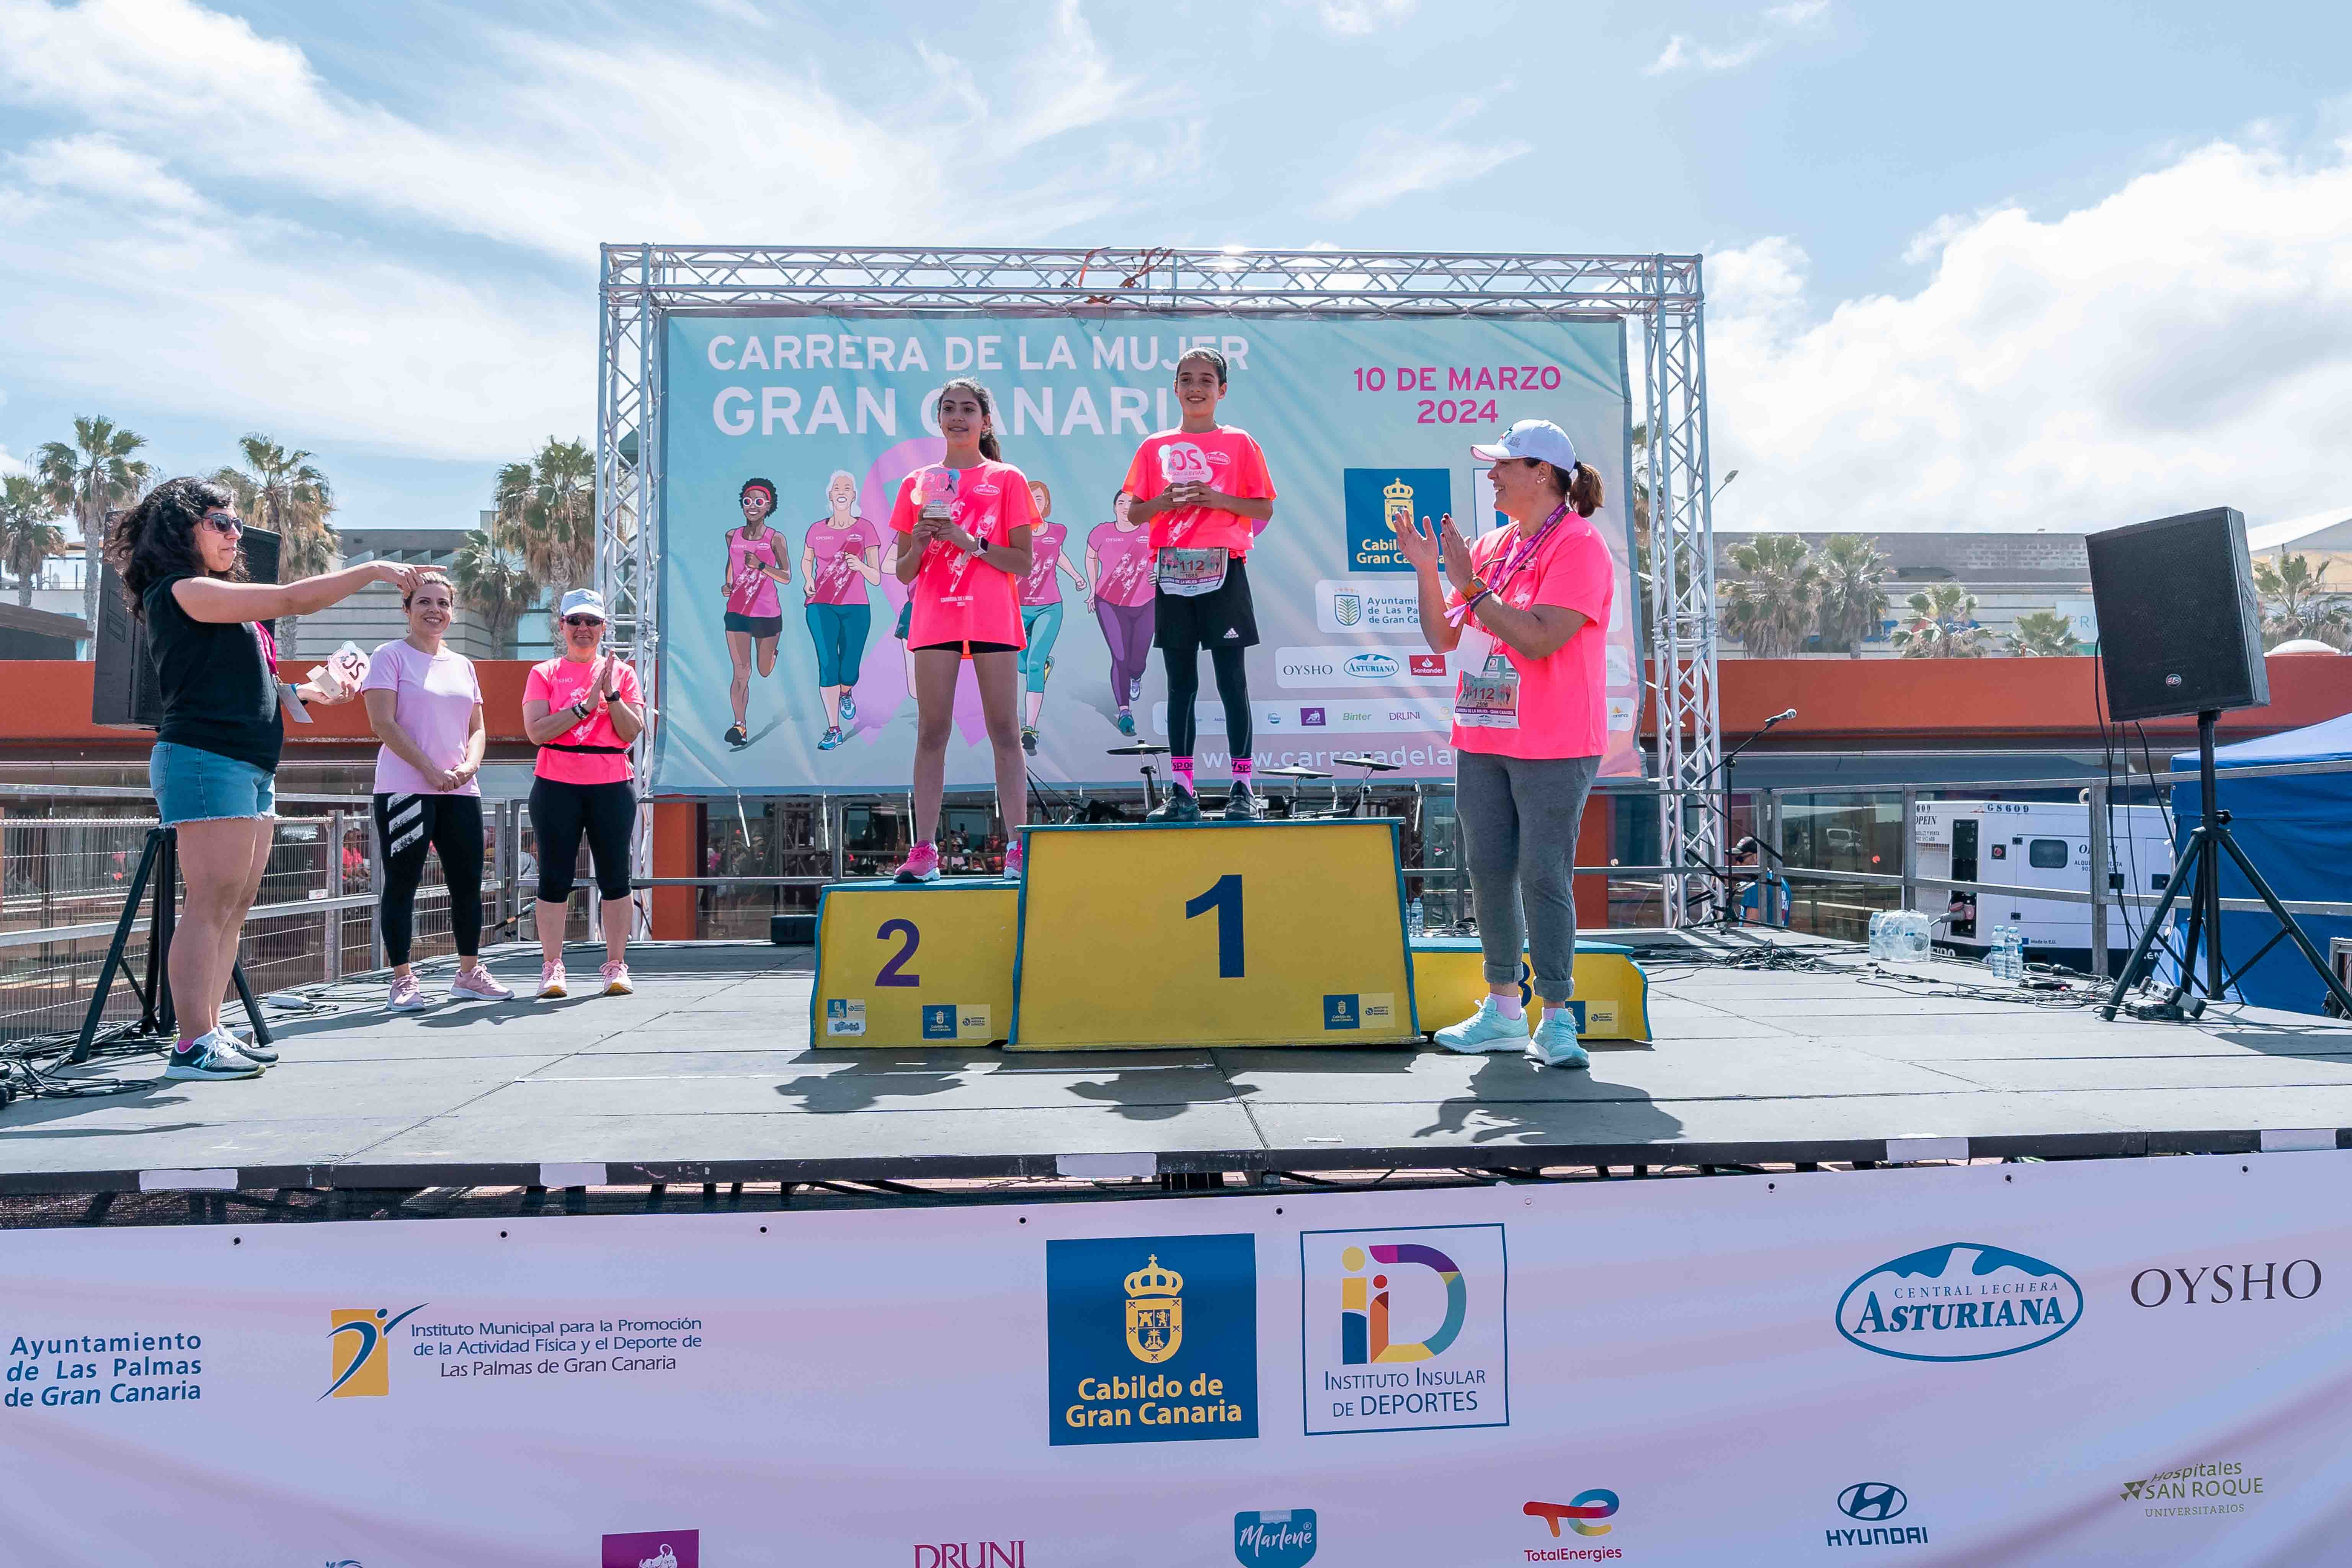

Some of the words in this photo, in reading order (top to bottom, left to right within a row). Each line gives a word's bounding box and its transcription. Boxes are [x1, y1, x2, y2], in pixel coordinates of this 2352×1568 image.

[708, 335, 929, 372] CARRERA
[946, 336, 996, 371] DE
[1018, 335, 1070, 369] LA
[1093, 336, 1249, 371] MUJR
[1354, 367, 1386, 391] 10
[1397, 367, 1436, 391] DE
[1449, 366, 1561, 391] MARZO
[713, 386, 895, 436] GRAN
[920, 386, 1184, 436] NARI
[1417, 399, 1498, 423] 2024
[1362, 539, 1397, 550] Cabil
[1179, 560, 1204, 571] 112
[1356, 552, 1390, 564] Gran
[1367, 597, 1416, 606] Ayuntami
[1283, 665, 1333, 675] OYSHO
[1348, 663, 1395, 672] ASTURIANA
[1473, 687, 1494, 699] 112
[1389, 712, 1420, 720] DRUNI
[1186, 874, 1245, 978] 1
[874, 918, 920, 987] 2
[1894, 1286, 1973, 1299] CENTRAL
[1981, 1282, 2059, 1295] LECHERA
[2131, 1259, 2322, 1308] OYSHO
[1854, 1291, 2065, 1334] ASTURIANA
[411, 1322, 474, 1337] Instituto
[479, 1321, 554, 1338] Municipal
[560, 1322, 594, 1336] para
[600, 1319, 612, 1332] la
[618, 1317, 702, 1331] Promoción
[10, 1332, 201, 1360] Ayuntamiento
[413, 1341, 434, 1356] de
[439, 1341, 452, 1356] la
[457, 1339, 530, 1355] Actividad
[536, 1338, 576, 1352] Física
[581, 1340, 590, 1354] y
[595, 1337, 608, 1350] el
[614, 1336, 677, 1352] Deporte
[682, 1334, 702, 1348] de
[7, 1361, 39, 1382] de
[56, 1360, 97, 1379] Las
[113, 1356, 201, 1377] Palmas
[441, 1362, 468, 1378] Las
[473, 1360, 532, 1376] Palmas
[537, 1359, 559, 1374] de
[564, 1357, 607, 1373] Gran
[611, 1355, 676, 1372] Canaria
[1078, 1374, 1183, 1401] Cabildo
[1189, 1373, 1223, 1397] de
[1325, 1370, 1409, 1390] INSTITUTO
[1416, 1367, 1486, 1387] INSULAR
[4, 1387, 33, 1407] de
[41, 1385, 100, 1406] Gran
[109, 1380, 201, 1403] Canaria
[1333, 1401, 1354, 1417] DE
[1361, 1391, 1478, 1416] DEPORTES
[1065, 1405, 1135, 1428] Gran
[1139, 1399, 1242, 1426] Canaria
[2151, 1460, 2242, 1483] Hospitales
[2145, 1482, 2185, 1500] SAN
[2192, 1477, 2263, 1498] ROQUE
[2145, 1503, 2245, 1517] UNIVERSITARIOS
[1240, 1524, 1312, 1557] Marlene
[1826, 1526, 1928, 1547] HYUNDAI
[913, 1540, 1026, 1568] DRUNI
[1524, 1545, 1622, 1563] TotalEnergies
